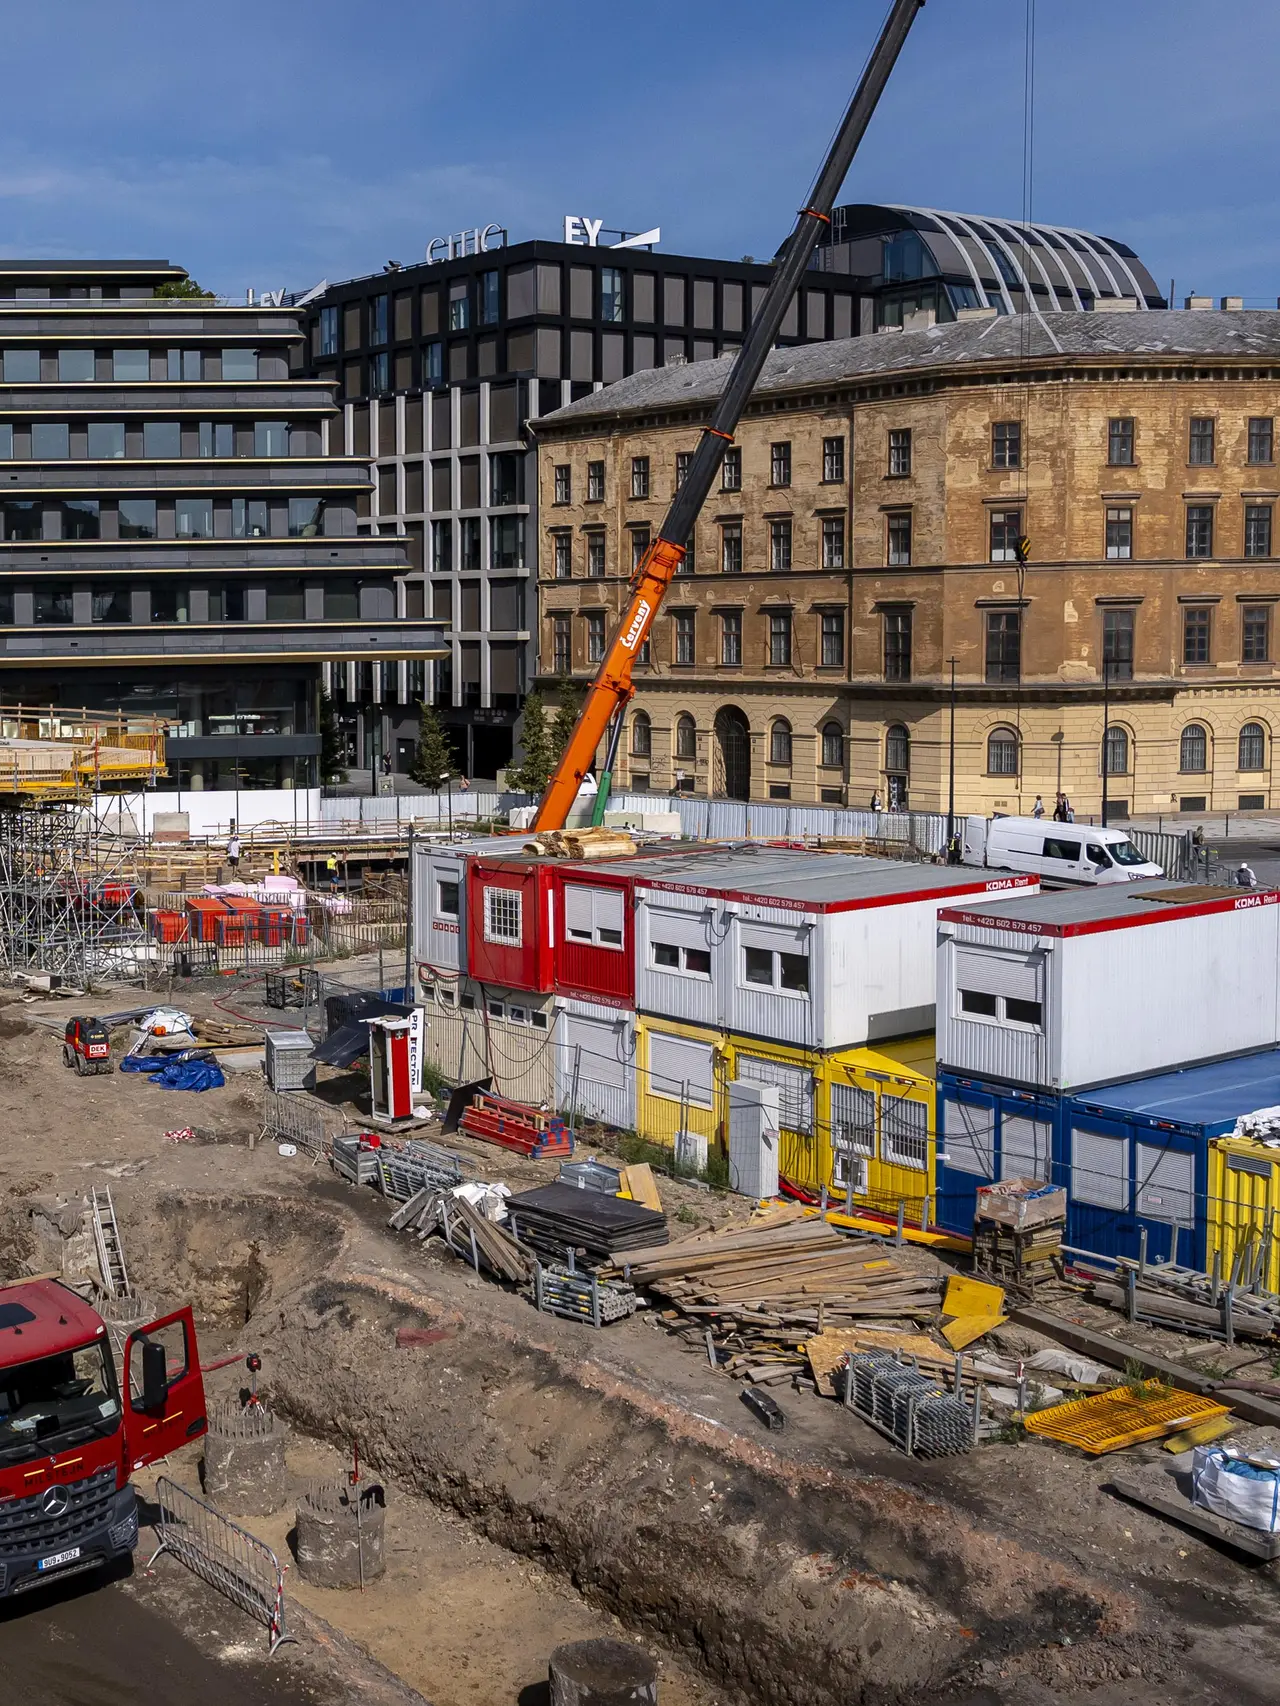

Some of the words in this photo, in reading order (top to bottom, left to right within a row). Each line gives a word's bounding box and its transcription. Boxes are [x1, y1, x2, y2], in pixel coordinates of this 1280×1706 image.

[564, 215, 603, 247] EY
[426, 223, 502, 265] CITIC
[620, 599, 651, 648] Červený
[661, 882, 674, 891] +420
[675, 884, 685, 892] 602
[686, 886, 697, 894] 579
[697, 887, 708, 895] 457
[986, 879, 1012, 891] KOMA
[1014, 878, 1029, 887] Rent
[754, 896, 768, 905] +420
[769, 898, 781, 907] 602
[781, 900, 793, 908] 579
[793, 901, 805, 909] 457
[1234, 896, 1262, 909] KOMA
[1263, 894, 1278, 904] Rent
[976, 916, 995, 926] +420
[996, 919, 1010, 929] 602
[1012, 921, 1026, 931] 579
[1027, 924, 1042, 932] 457
[43, 1558, 57, 1567] 9U9
[60, 1549, 77, 1561] 9052
